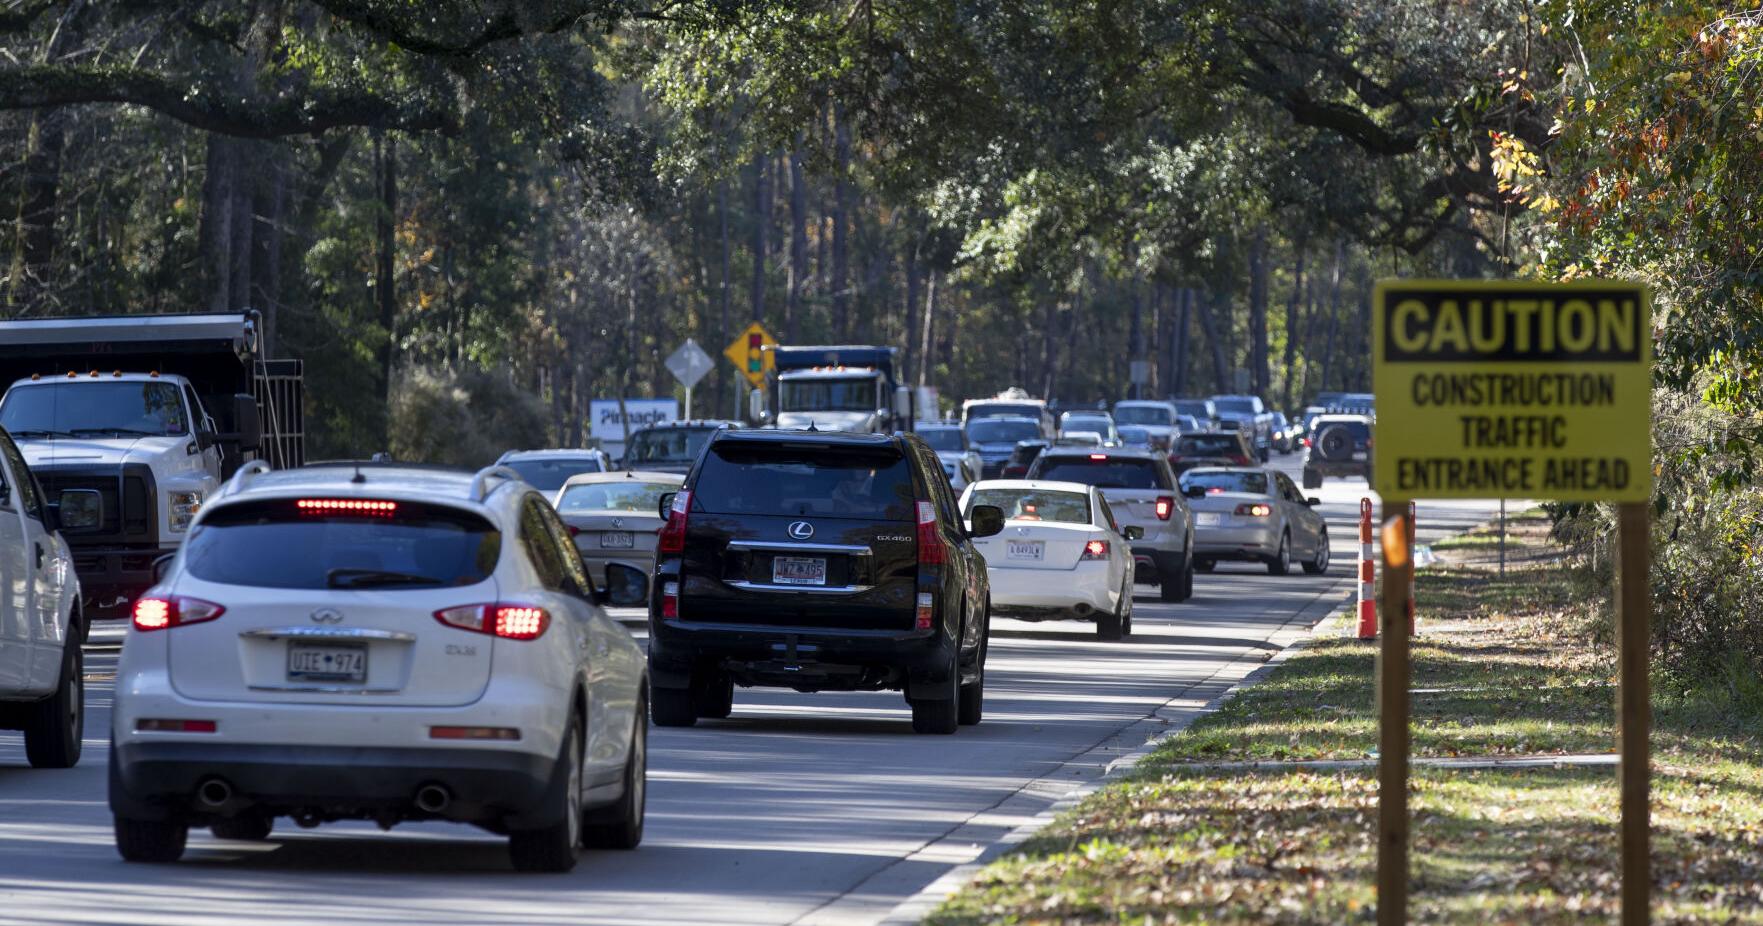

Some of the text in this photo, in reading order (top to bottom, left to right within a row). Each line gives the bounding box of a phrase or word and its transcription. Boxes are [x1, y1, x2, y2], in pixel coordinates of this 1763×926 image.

[1391, 300, 1634, 351] CAUTION
[1413, 373, 1615, 406] CONSTRUCTION
[1460, 415, 1567, 448] TRAFFIC
[1397, 457, 1630, 490] ENTRANCE AHEAD
[335, 653, 362, 672] 974
